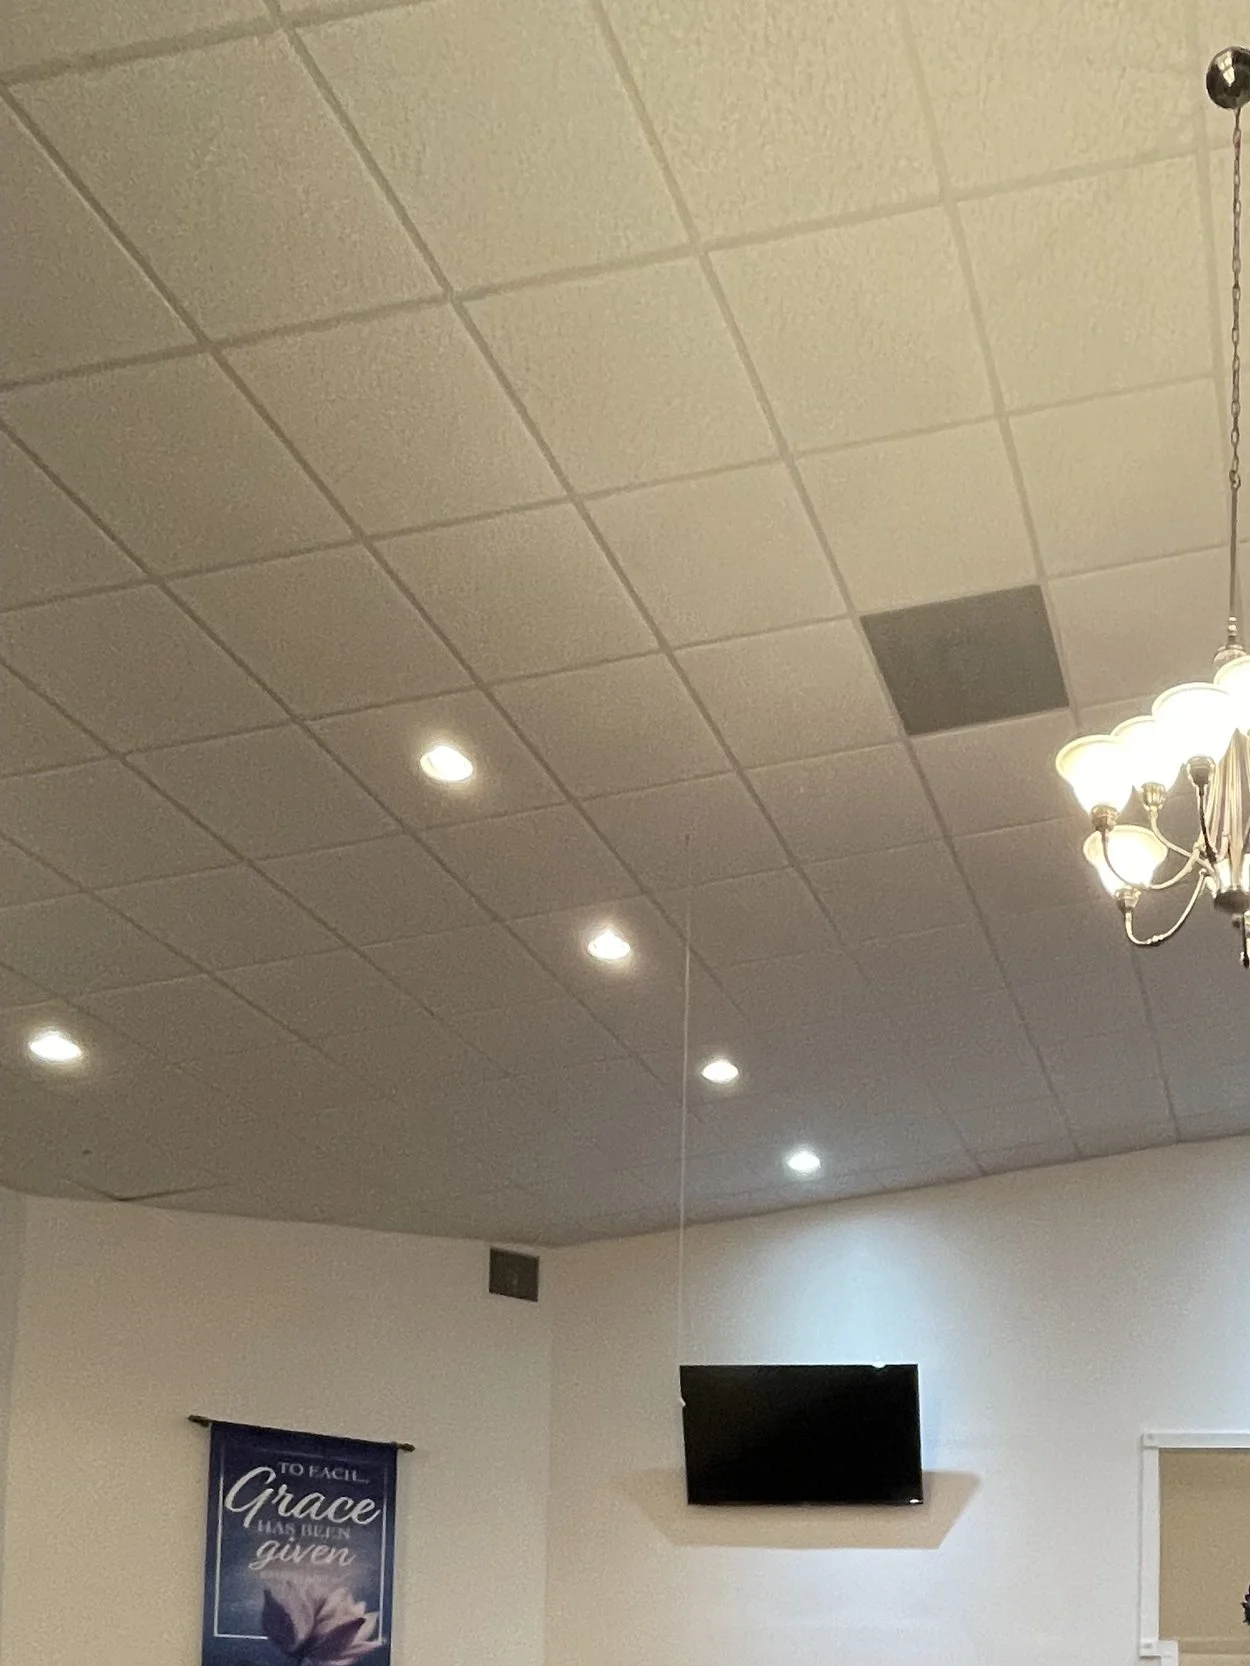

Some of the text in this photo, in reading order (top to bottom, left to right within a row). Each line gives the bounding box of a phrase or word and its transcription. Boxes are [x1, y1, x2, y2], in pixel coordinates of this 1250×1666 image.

[277, 1461, 304, 1477] TO
[224, 1466, 381, 1528] Grace
[256, 1519, 351, 1540] HAS BEEN
[248, 1537, 356, 1571] given
